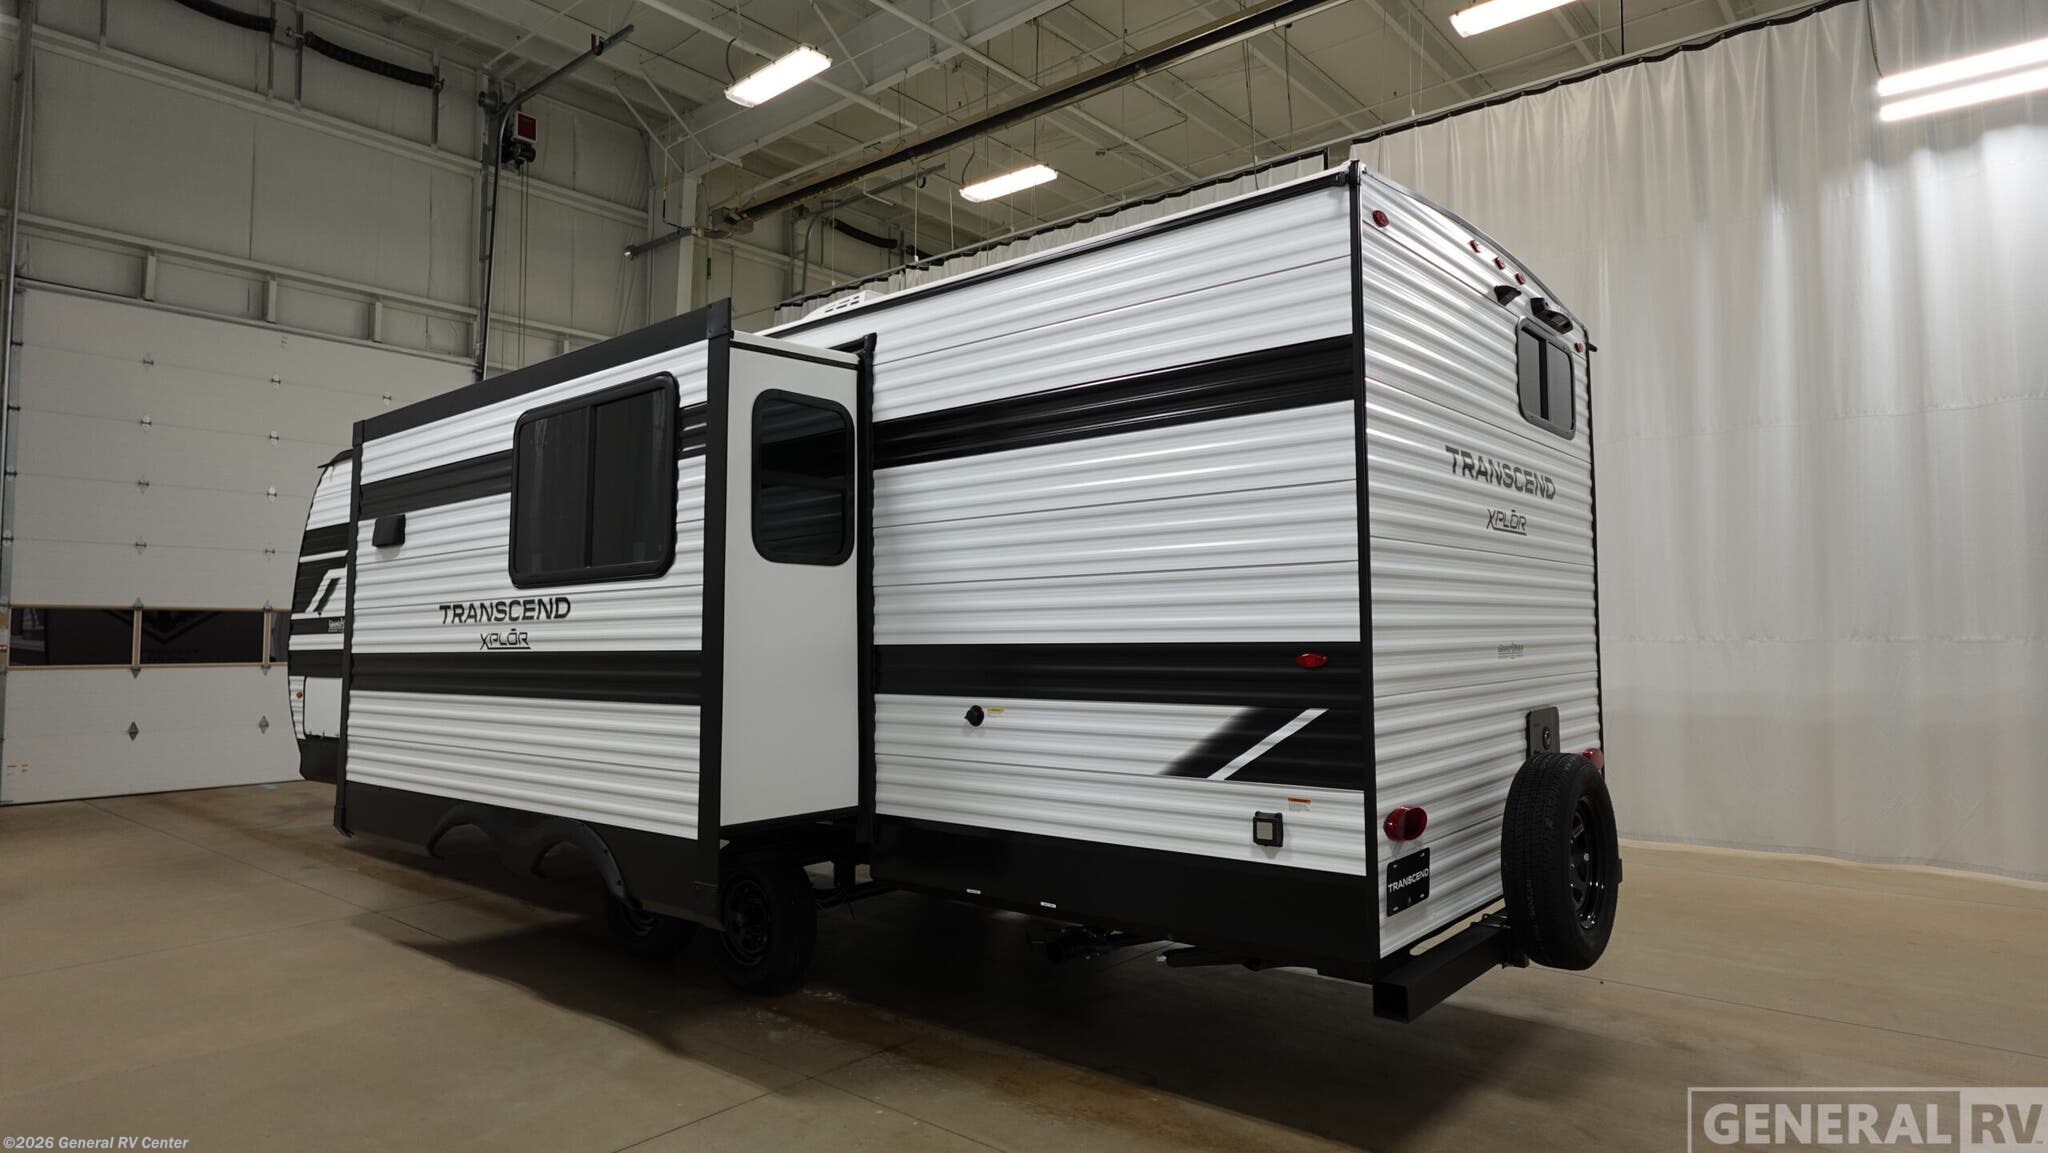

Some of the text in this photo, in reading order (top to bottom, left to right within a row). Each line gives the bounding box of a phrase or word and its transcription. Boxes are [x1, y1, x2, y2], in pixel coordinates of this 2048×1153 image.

[1445, 445, 1556, 500] TRANSCEND
[439, 597, 571, 624] TRANSCEND
[1387, 868, 1429, 893] TRANSCEND
